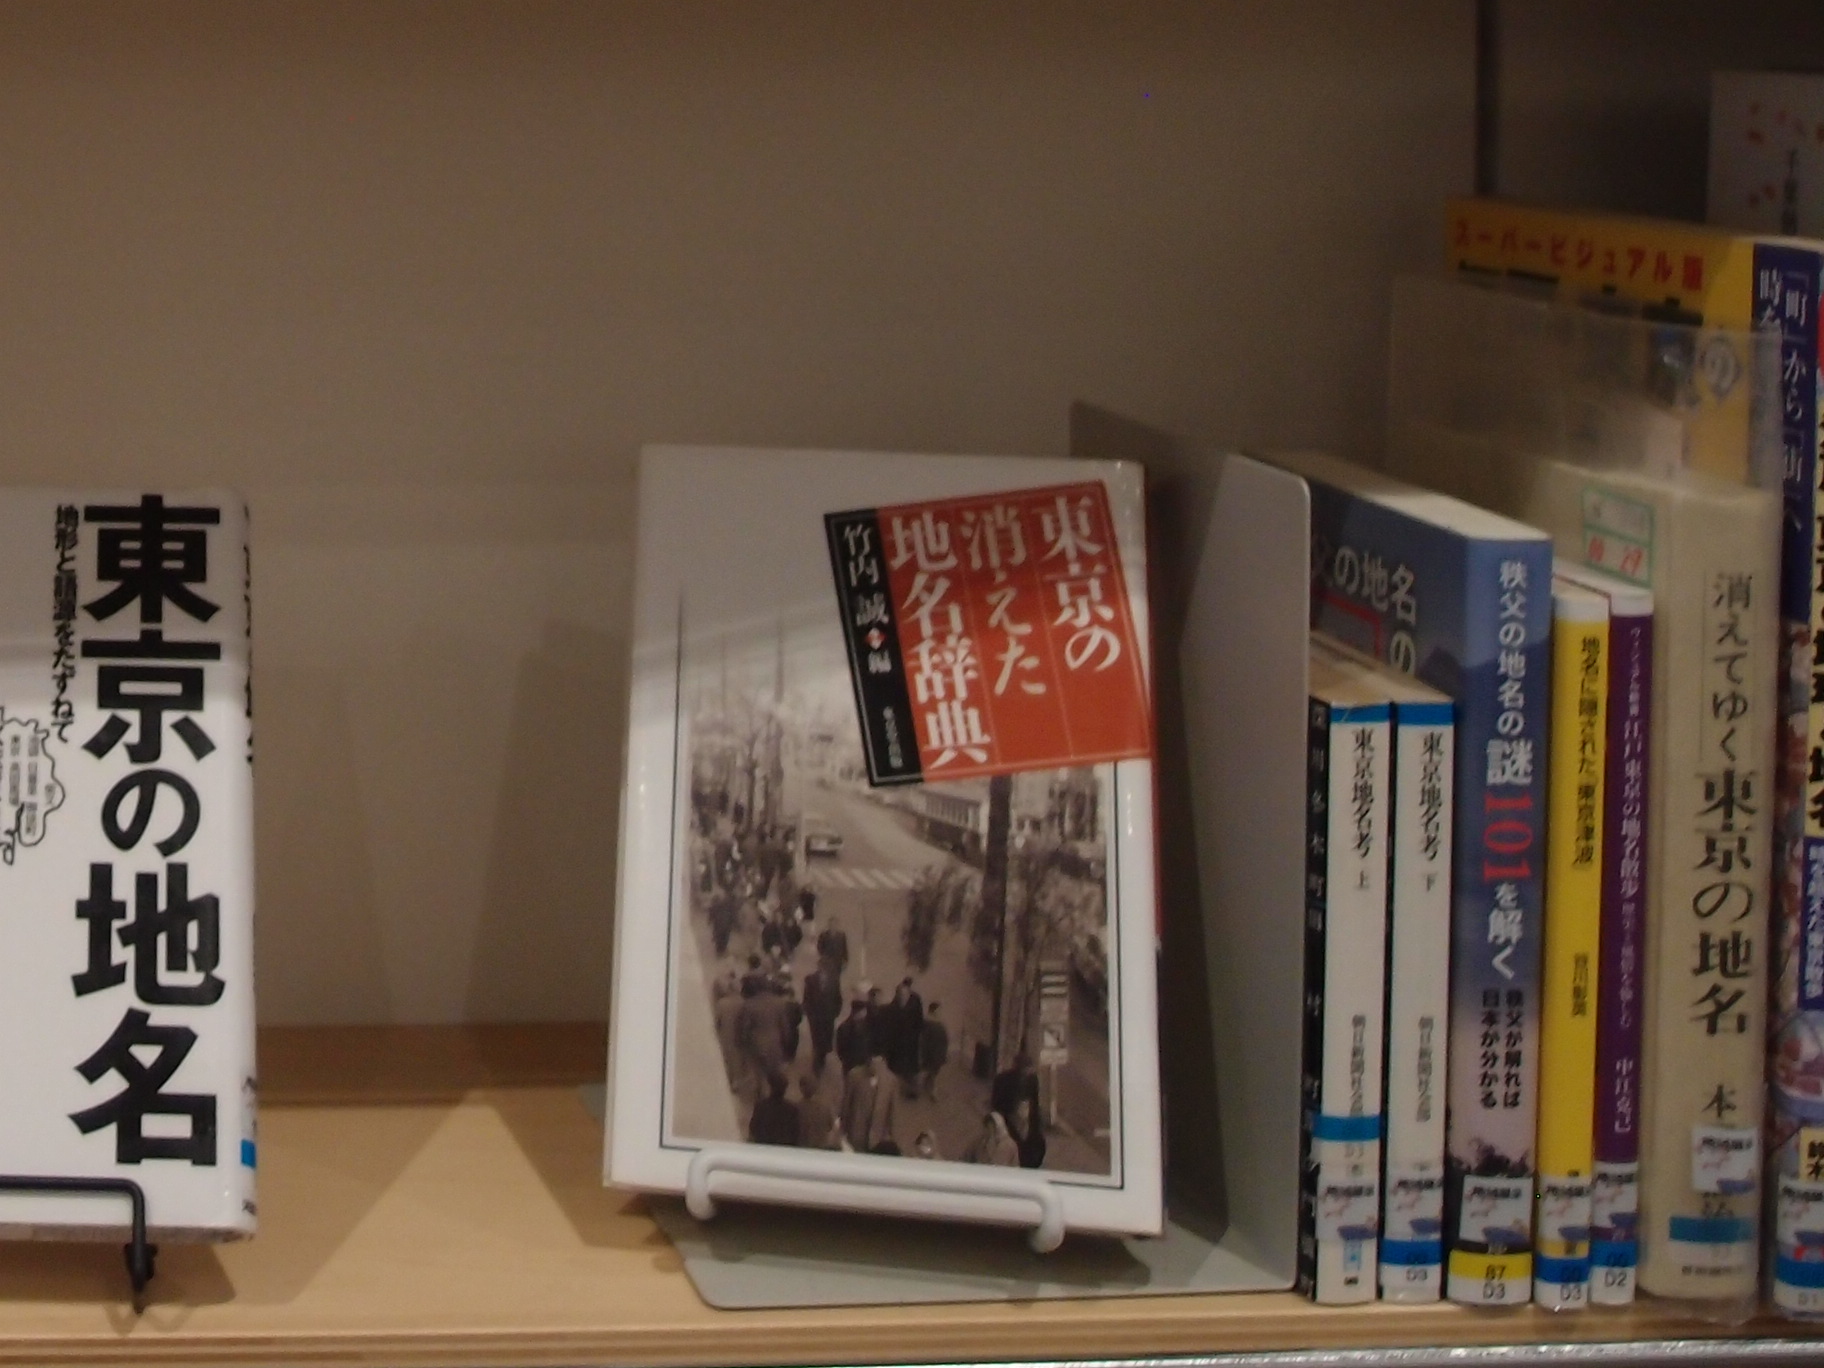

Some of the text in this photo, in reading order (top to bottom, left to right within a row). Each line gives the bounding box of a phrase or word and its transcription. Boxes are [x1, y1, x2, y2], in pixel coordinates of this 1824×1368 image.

[890, 510, 991, 769] 地名辞典
[962, 505, 1046, 695] 消えた
[1034, 496, 1121, 671] 東京の
[68, 494, 226, 1168] 東京の地名
